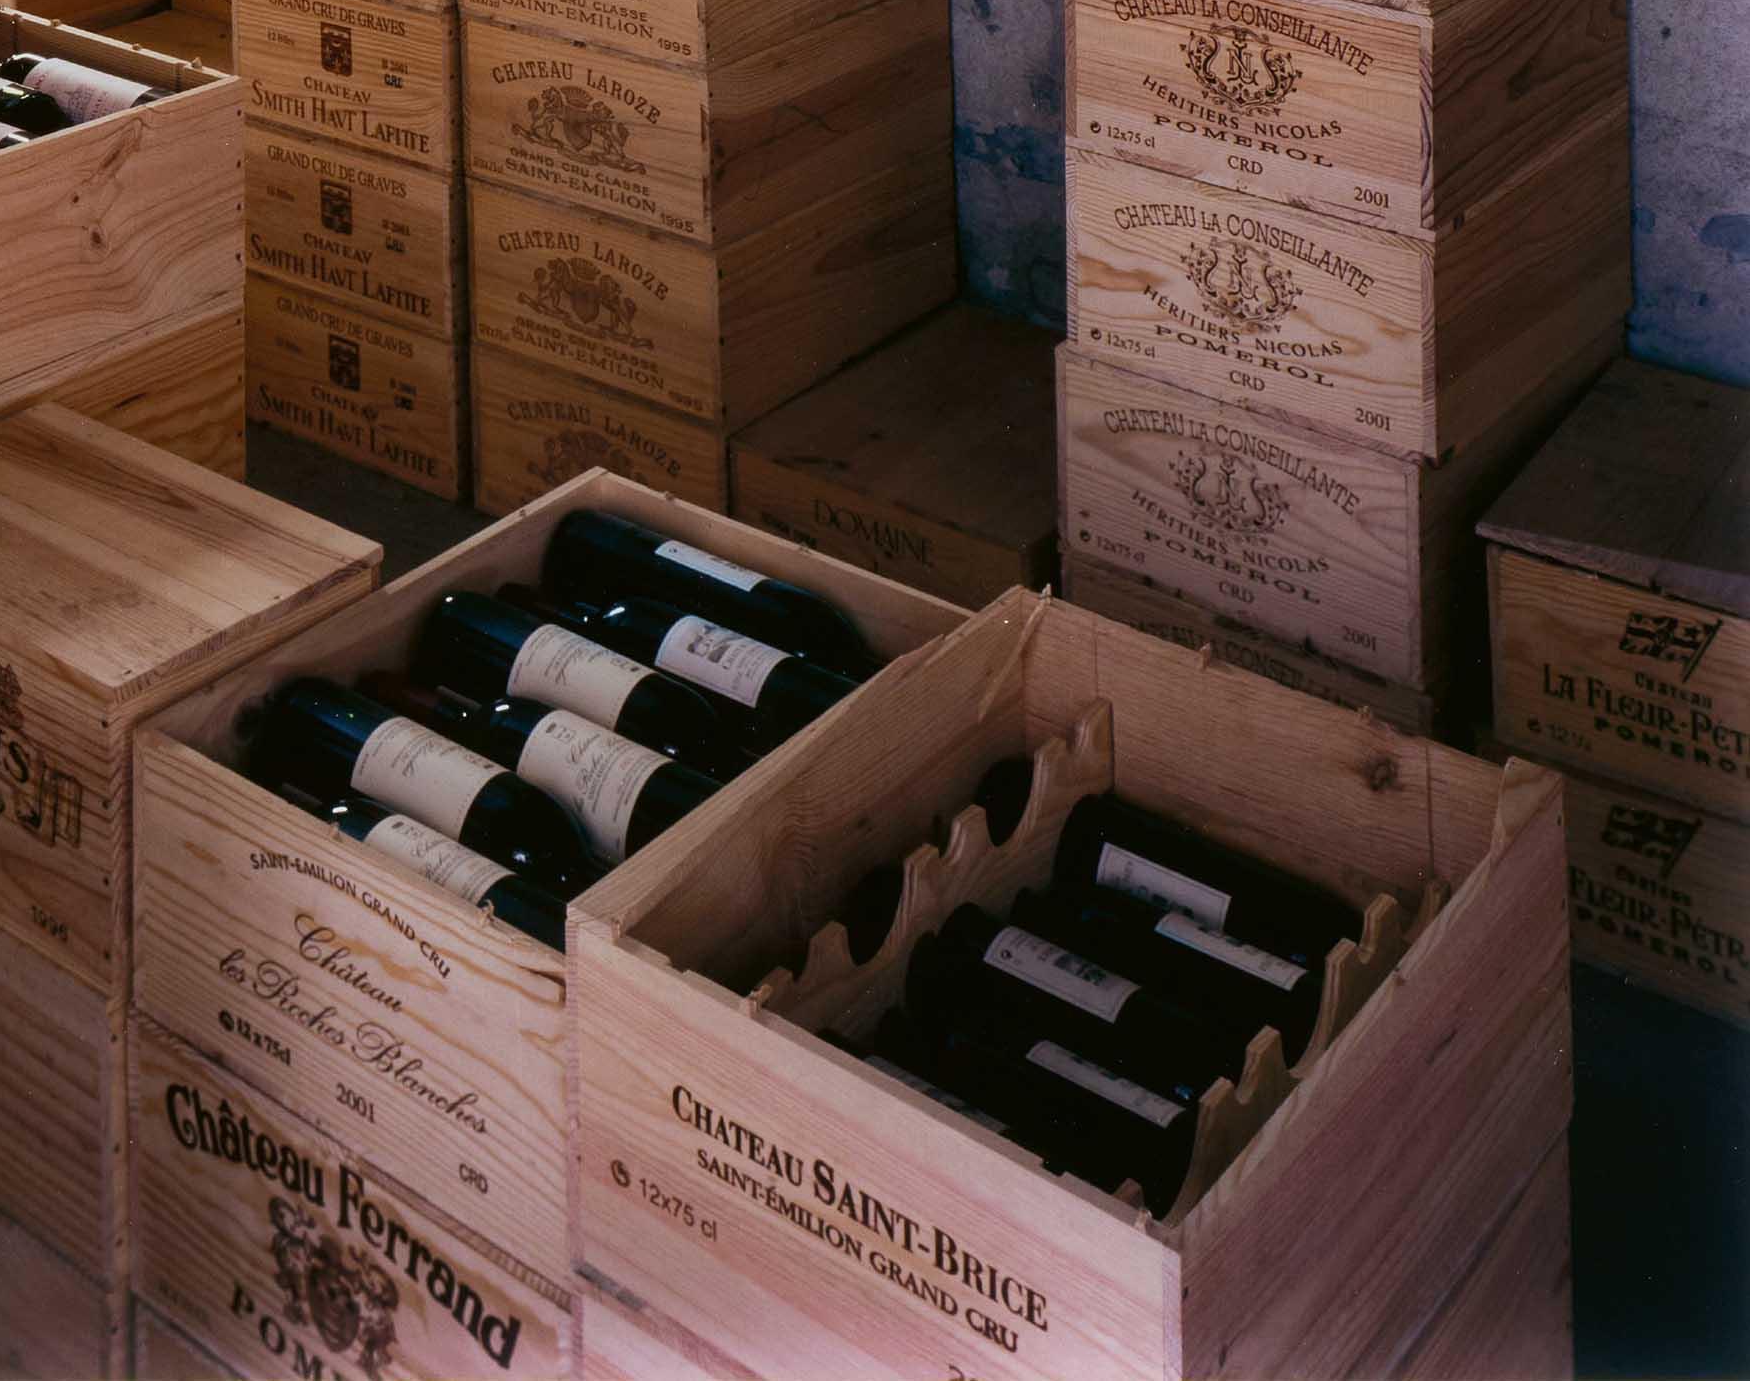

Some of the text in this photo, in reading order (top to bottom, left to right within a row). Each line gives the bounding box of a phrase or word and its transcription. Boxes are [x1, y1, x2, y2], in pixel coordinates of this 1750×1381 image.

[592, 0, 648, 22] CLASSE
[1200, 0, 1374, 76] LA CONSEILLANTE
[657, 36, 692, 56] 1995
[492, 61, 662, 124] CHATEAU LAROZE
[362, 109, 430, 153] LAFITTE
[1152, 114, 1334, 168] POMEROL
[1254, 120, 1343, 140] NICOLAS
[505, 157, 656, 215] SAINT-EMILION
[1227, 155, 1264, 175] CRD
[660, 210, 694, 234] 1995
[1200, 209, 1375, 297] LA CONSEILLANTE
[1153, 326, 1335, 387] POMEROL
[1254, 339, 1344, 359] NICOLAS
[1229, 370, 1265, 392] CRD
[1188, 419, 1360, 516] LA CONSEILLANTE
[1143, 529, 1322, 605] POMEROL
[1242, 550, 1331, 573] NICOLAS
[1542, 663, 1576, 702] LA
[295, 914, 404, 1013] Château
[362, 891, 451, 980] GRAND CRU
[220, 948, 245, 984] les
[351, 1020, 489, 1134] Blanches
[336, 1082, 375, 1124] 2001
[459, 1163, 489, 1194] CRD
[167, 1084, 324, 1207] Château
[337, 1163, 521, 1370] Ferrand
[672, 1084, 1049, 1333] CHATEAU SAINT-BRICE
[697, 1149, 1018, 1354] SAINT-ÉMILION GRAND CRU
